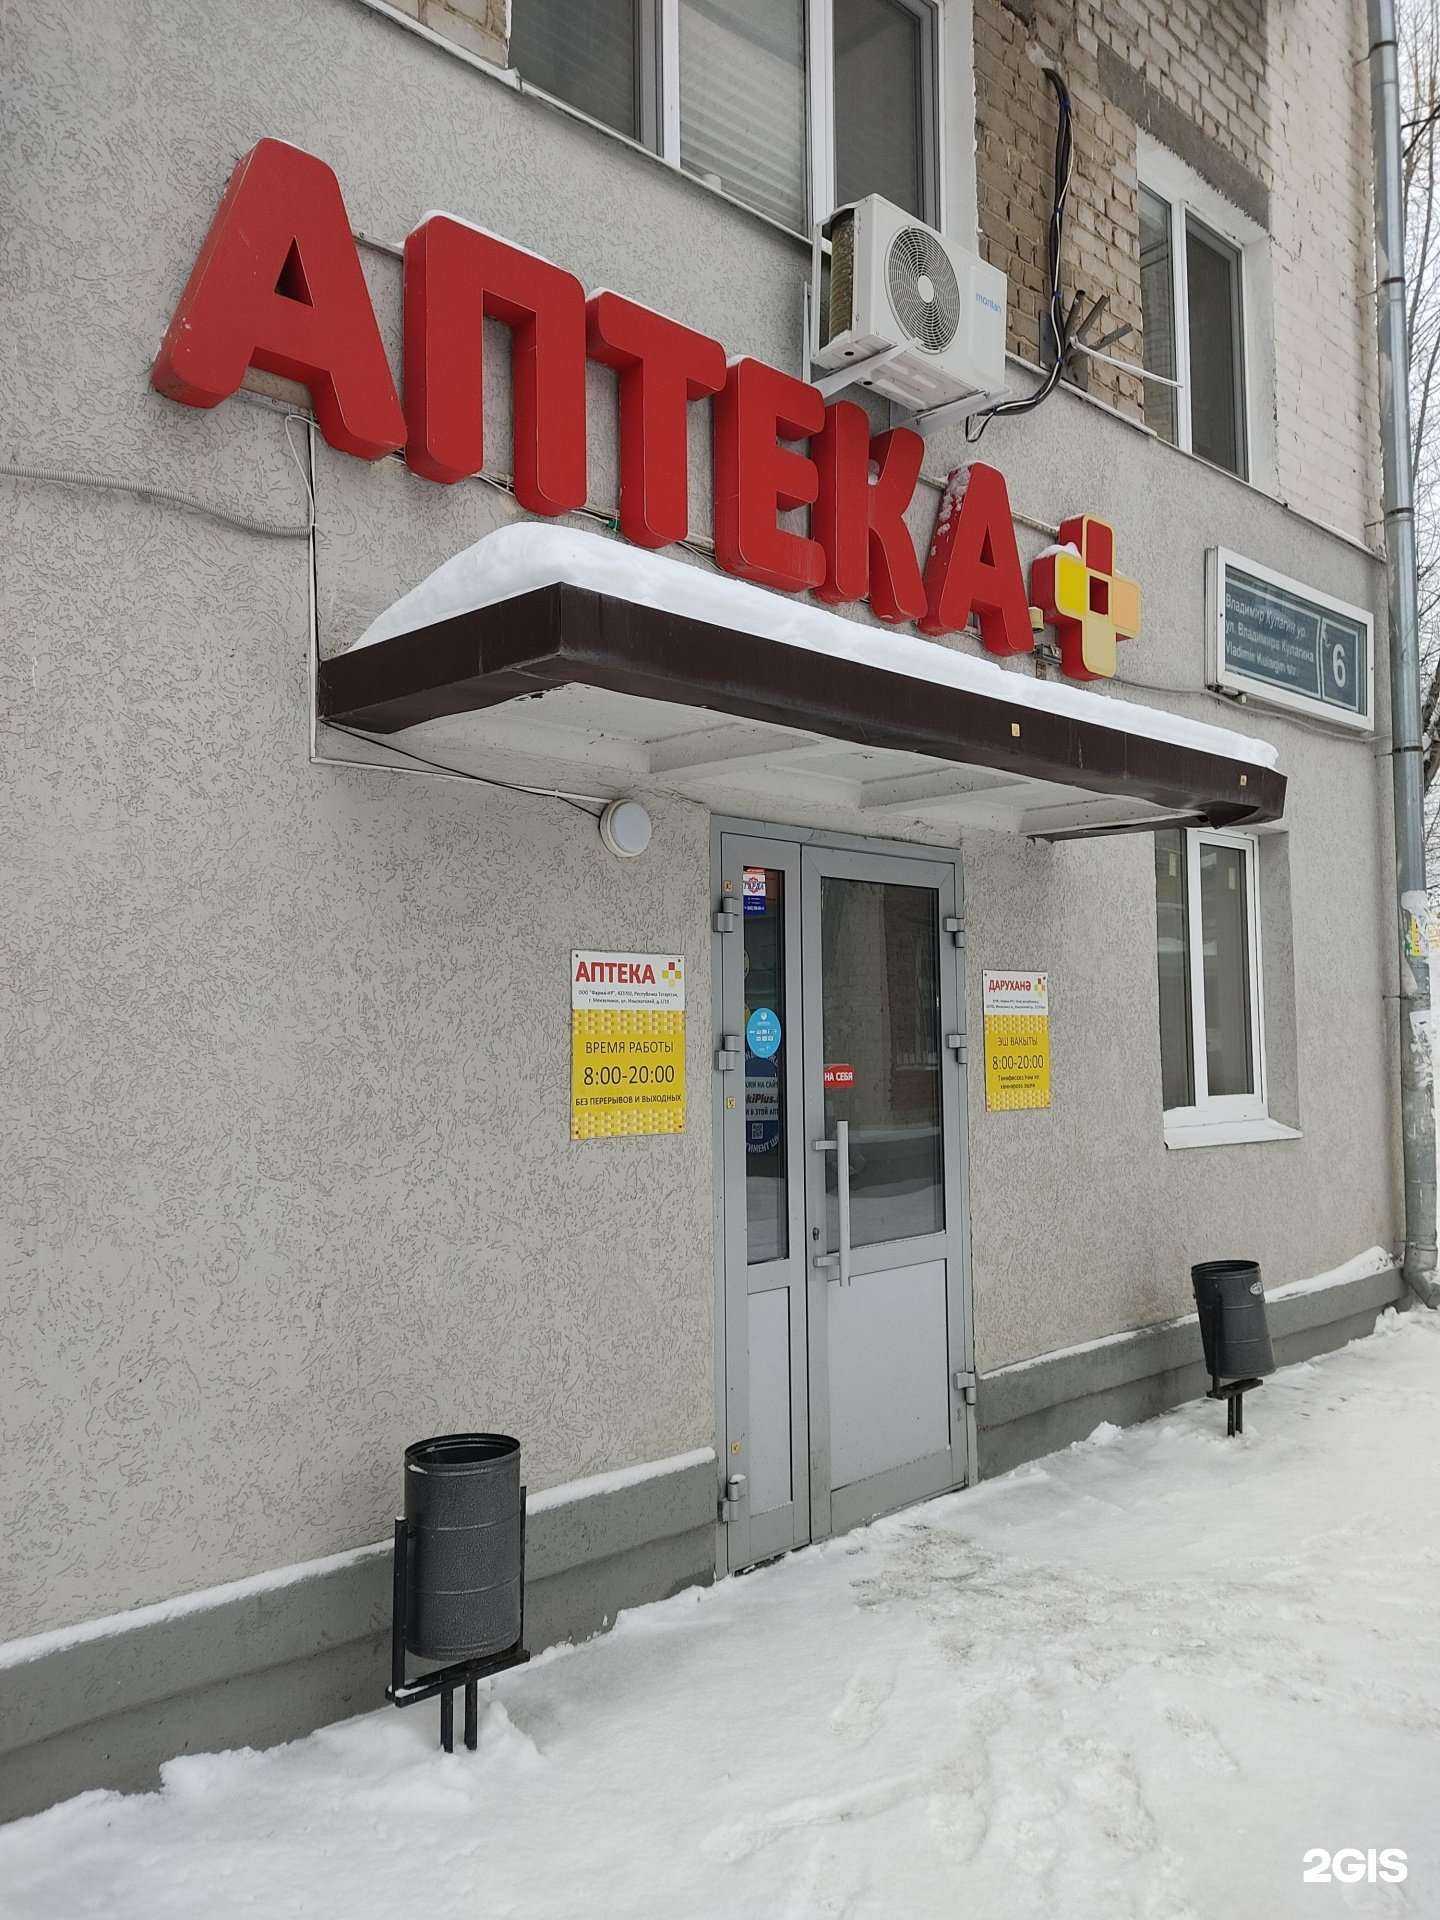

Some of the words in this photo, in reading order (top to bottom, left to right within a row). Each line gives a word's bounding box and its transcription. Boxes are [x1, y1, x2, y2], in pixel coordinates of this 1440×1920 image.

[151, 137, 1033, 657] АПТЕКА
[1225, 593, 1264, 625] Владимир
[1265, 608, 1296, 633] Кулагин
[1281, 639, 1314, 663] Кулагина
[1332, 643, 1346, 688] 6
[575, 961, 656, 985] АПТЕКА
[988, 979, 1031, 992] ДАРУХАНӘ
[585, 1041, 625, 1054] ВРЕМЯ
[629, 1040, 674, 1053] РАБОТЫ
[997, 1036, 1009, 1046] ЭШ
[1010, 1036, 1038, 1046] ВАКЫТЫ
[992, 1054, 1044, 1070] 8:00-20:00
[583, 1065, 675, 1086] 8:00-20:00
[824, 1071, 834, 1081] НА
[835, 1071, 853, 1081] СЕБЯ
[575, 1098, 588, 1106] БЕЗ
[590, 1096, 633, 1105] ПЕРЕРЫВОВ
[634, 1095, 640, 1103] И
[642, 1094, 682, 1103] ВЫХОДНЫХ
